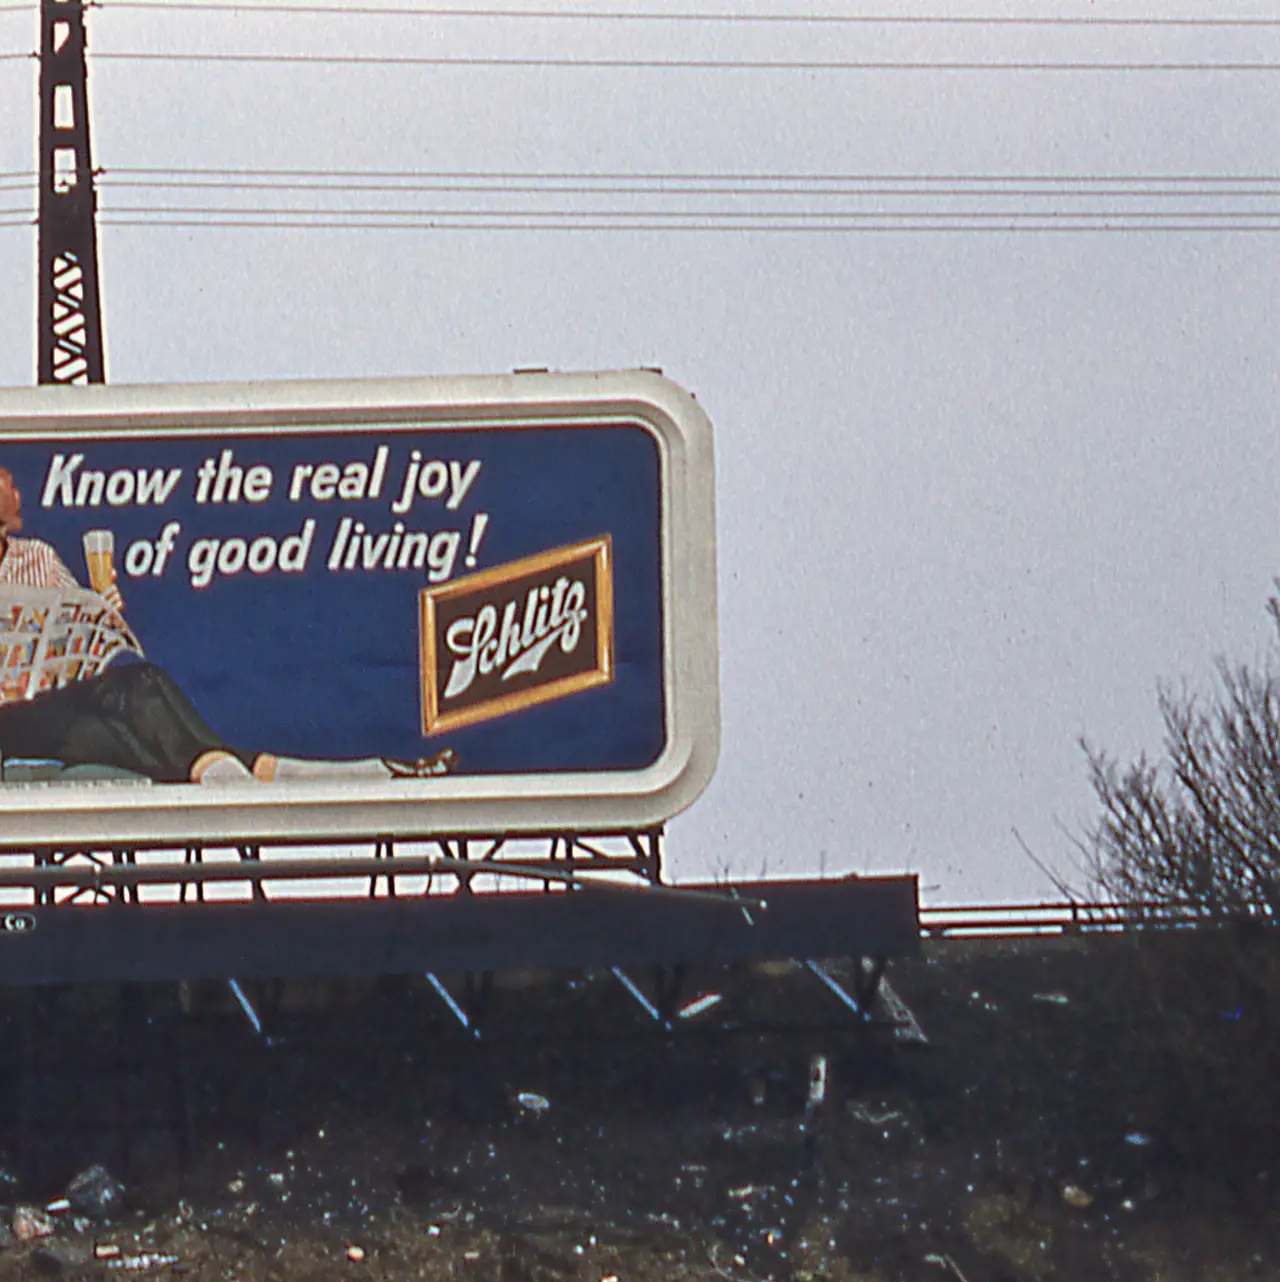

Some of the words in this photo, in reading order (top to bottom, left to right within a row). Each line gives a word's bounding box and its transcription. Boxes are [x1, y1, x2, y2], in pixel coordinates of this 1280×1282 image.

[42, 453, 182, 507] Know
[195, 449, 273, 503] the
[289, 445, 389, 500] real
[391, 450, 481, 514] joy
[125, 522, 181, 578] of
[188, 518, 316, 588] good
[328, 513, 489, 582] living!
[444, 576, 588, 698] Schlitz
